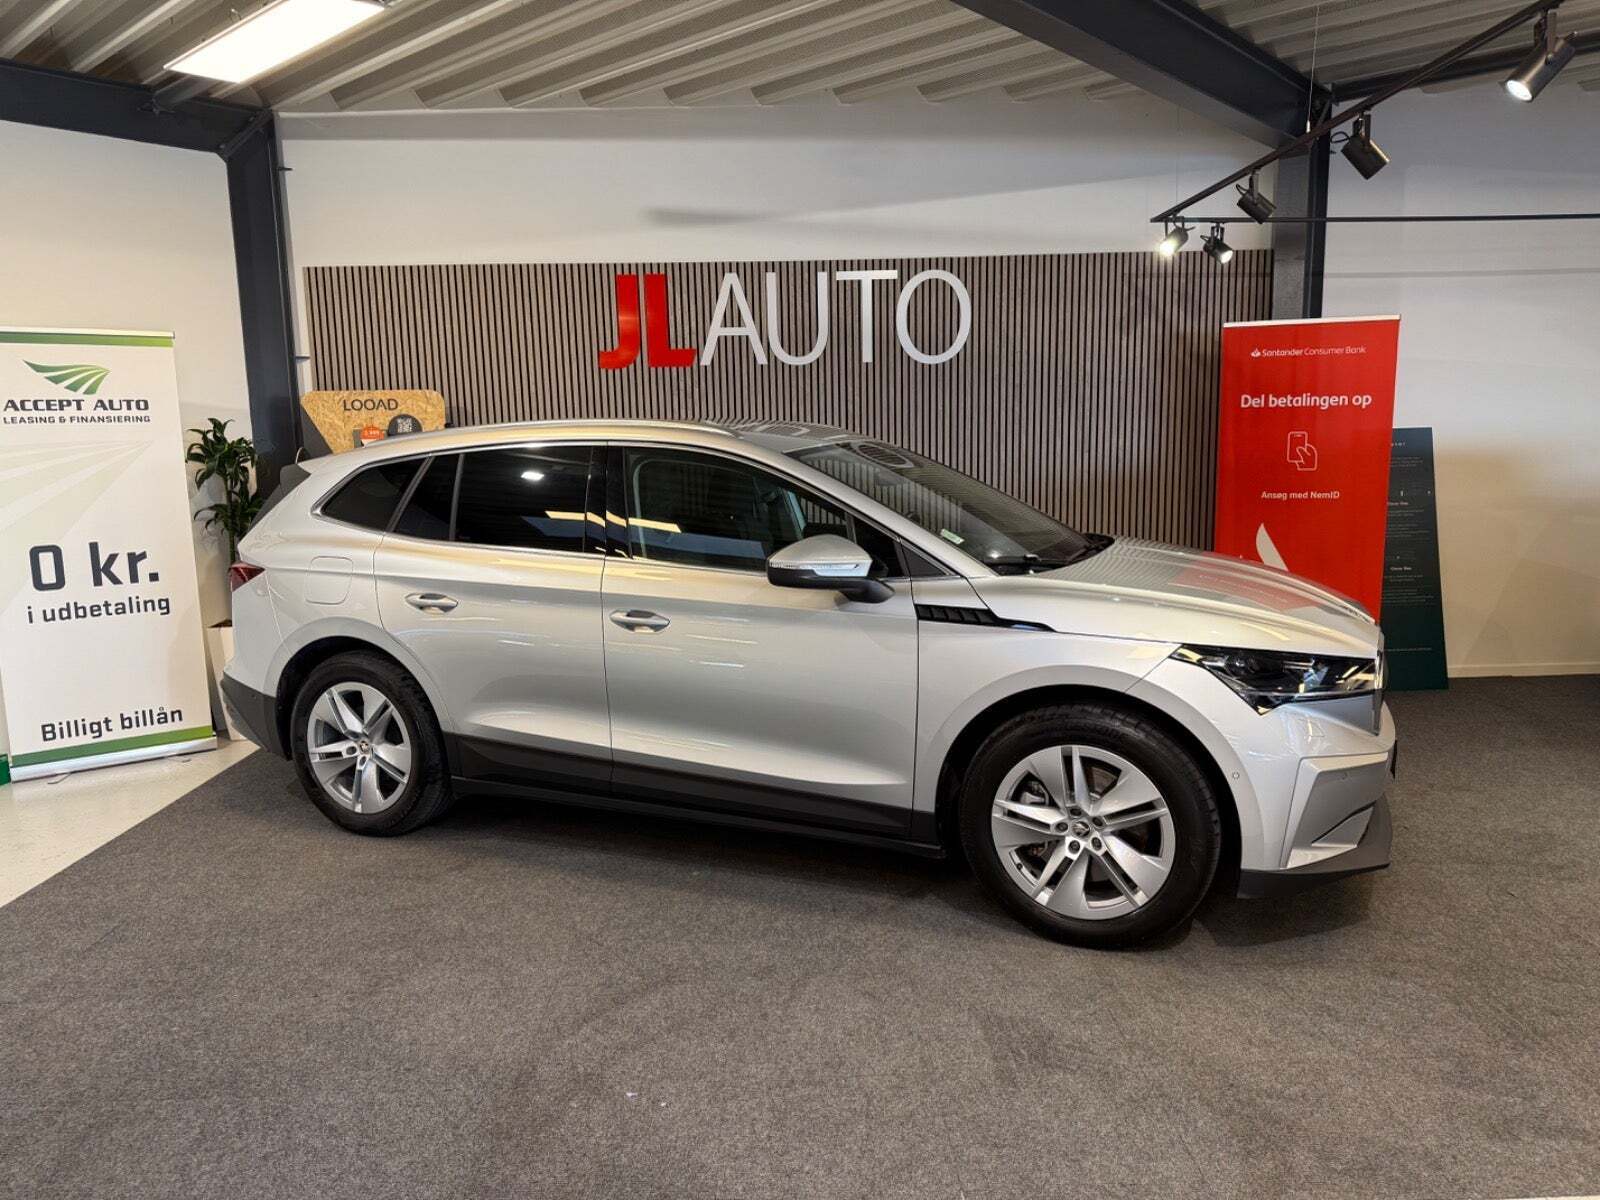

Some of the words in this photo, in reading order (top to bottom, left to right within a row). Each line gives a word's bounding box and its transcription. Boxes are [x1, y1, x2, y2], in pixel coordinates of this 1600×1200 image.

[598, 273, 697, 370] JL
[700, 269, 972, 366] AUTO
[1262, 347, 1303, 357] Santander
[1304, 346, 1344, 356] Consumer
[1345, 345, 1366, 354] Bank
[3, 399, 85, 412] ACCEPT
[93, 399, 150, 412] AUTO
[343, 398, 399, 412] LOOAD
[1240, 394, 1265, 409] Del
[1268, 392, 1349, 410] betalingen
[1352, 394, 1372, 409] op
[3, 415, 56, 424] LEASING
[58, 415, 67, 424] &
[69, 415, 151, 424] FINANSIERING
[1261, 491, 1287, 501] Ansøg
[1289, 491, 1308, 499] med
[1310, 490, 1340, 499] NemID
[29, 544, 66, 592] 0
[88, 541, 159, 588] kr.
[27, 605, 34, 624] i
[42, 595, 171, 623] udbetaling
[41, 715, 113, 742] Billigt
[119, 706, 184, 731] billån
